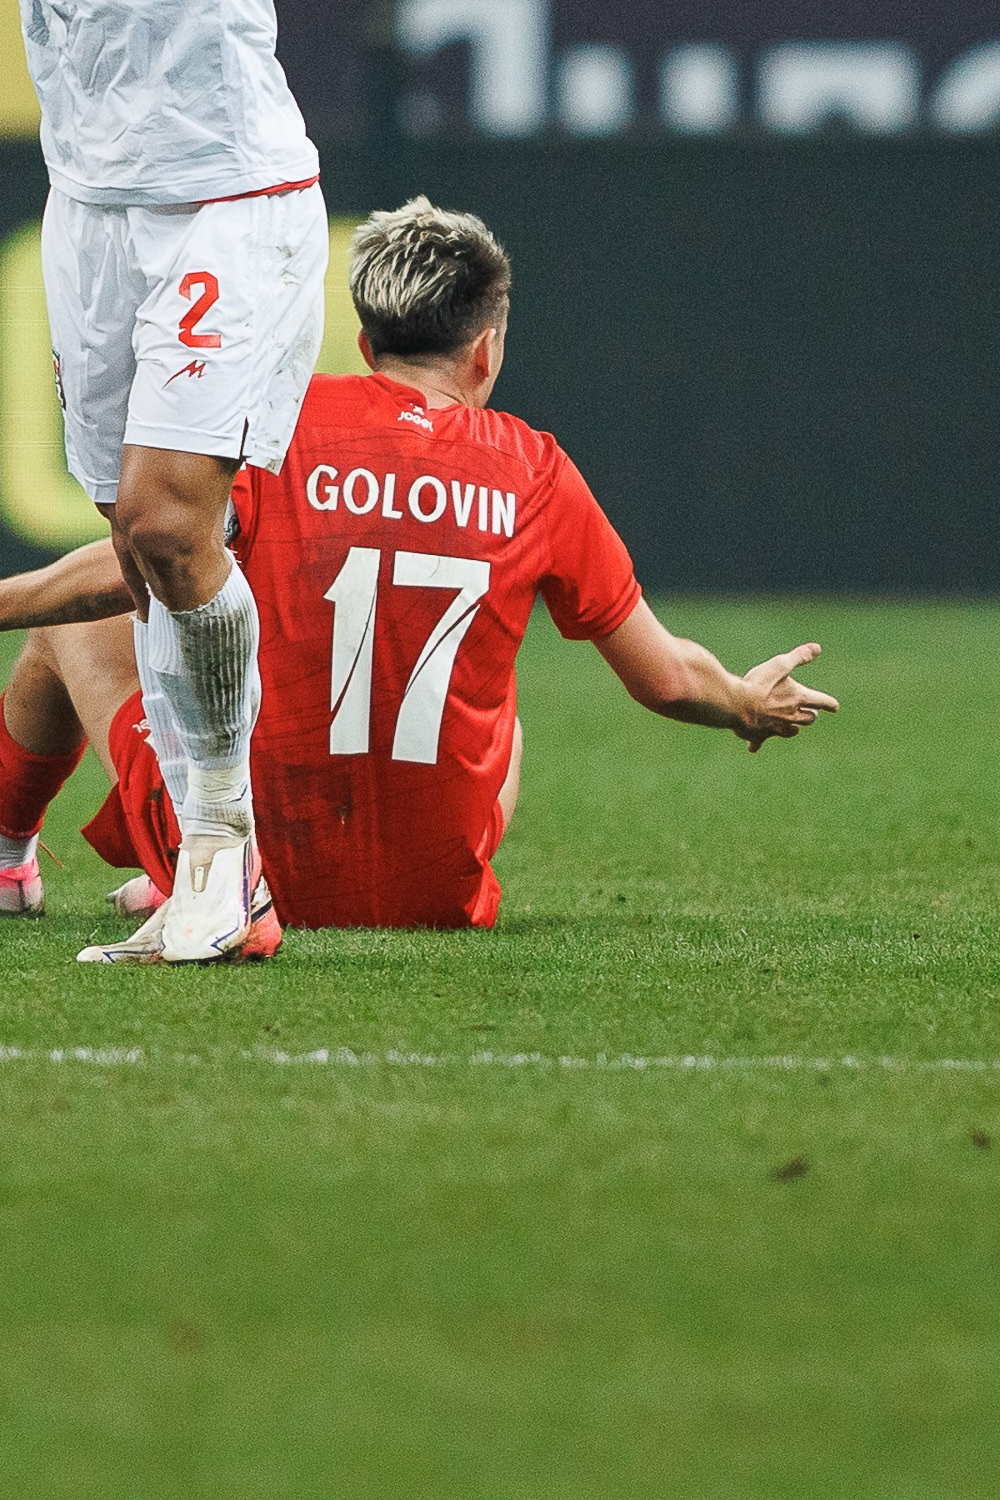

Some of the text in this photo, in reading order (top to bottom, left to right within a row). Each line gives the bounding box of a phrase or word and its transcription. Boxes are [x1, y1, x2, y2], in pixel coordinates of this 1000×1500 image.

[178, 271, 222, 349] 2
[306, 464, 516, 538] GOLOVIN
[323, 546, 491, 765] 17
